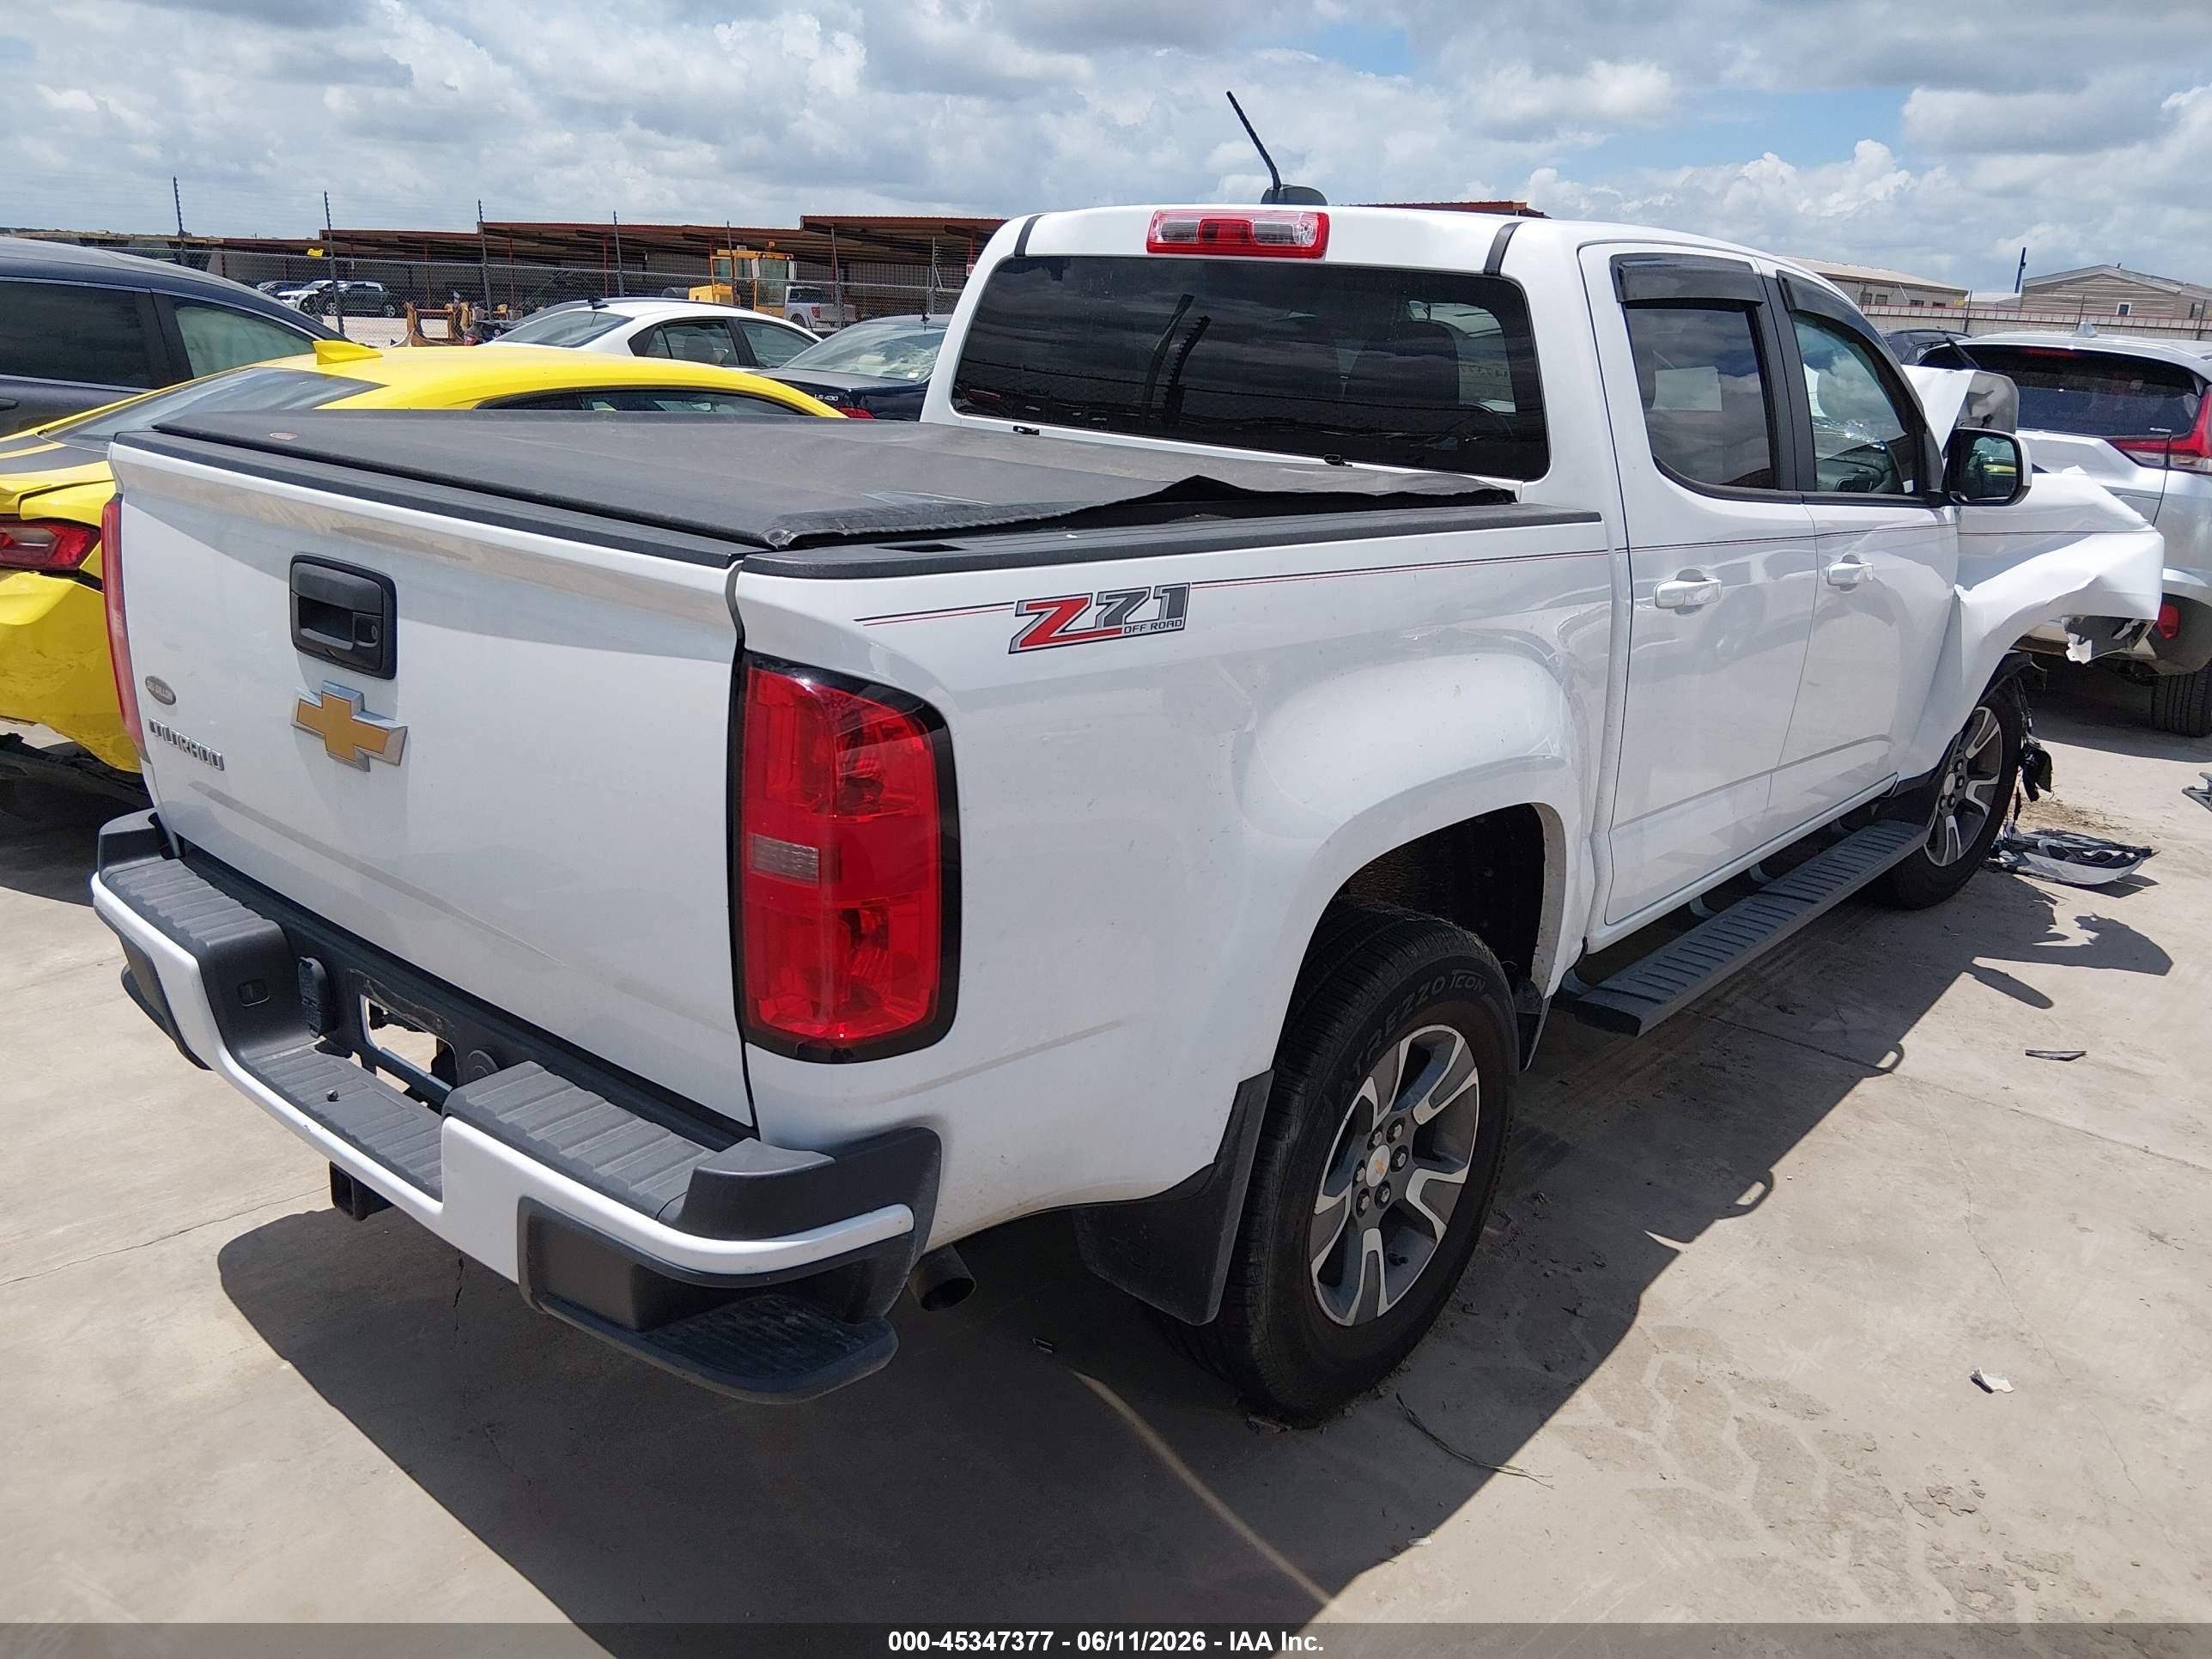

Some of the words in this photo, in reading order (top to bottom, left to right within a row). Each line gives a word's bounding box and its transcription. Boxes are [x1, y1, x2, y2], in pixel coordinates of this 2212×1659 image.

[1007, 582, 1190, 654] Z71
[1124, 624, 1147, 635] OFF
[1150, 618, 1183, 631] ROAD
[1449, 969, 1488, 993] ICON
